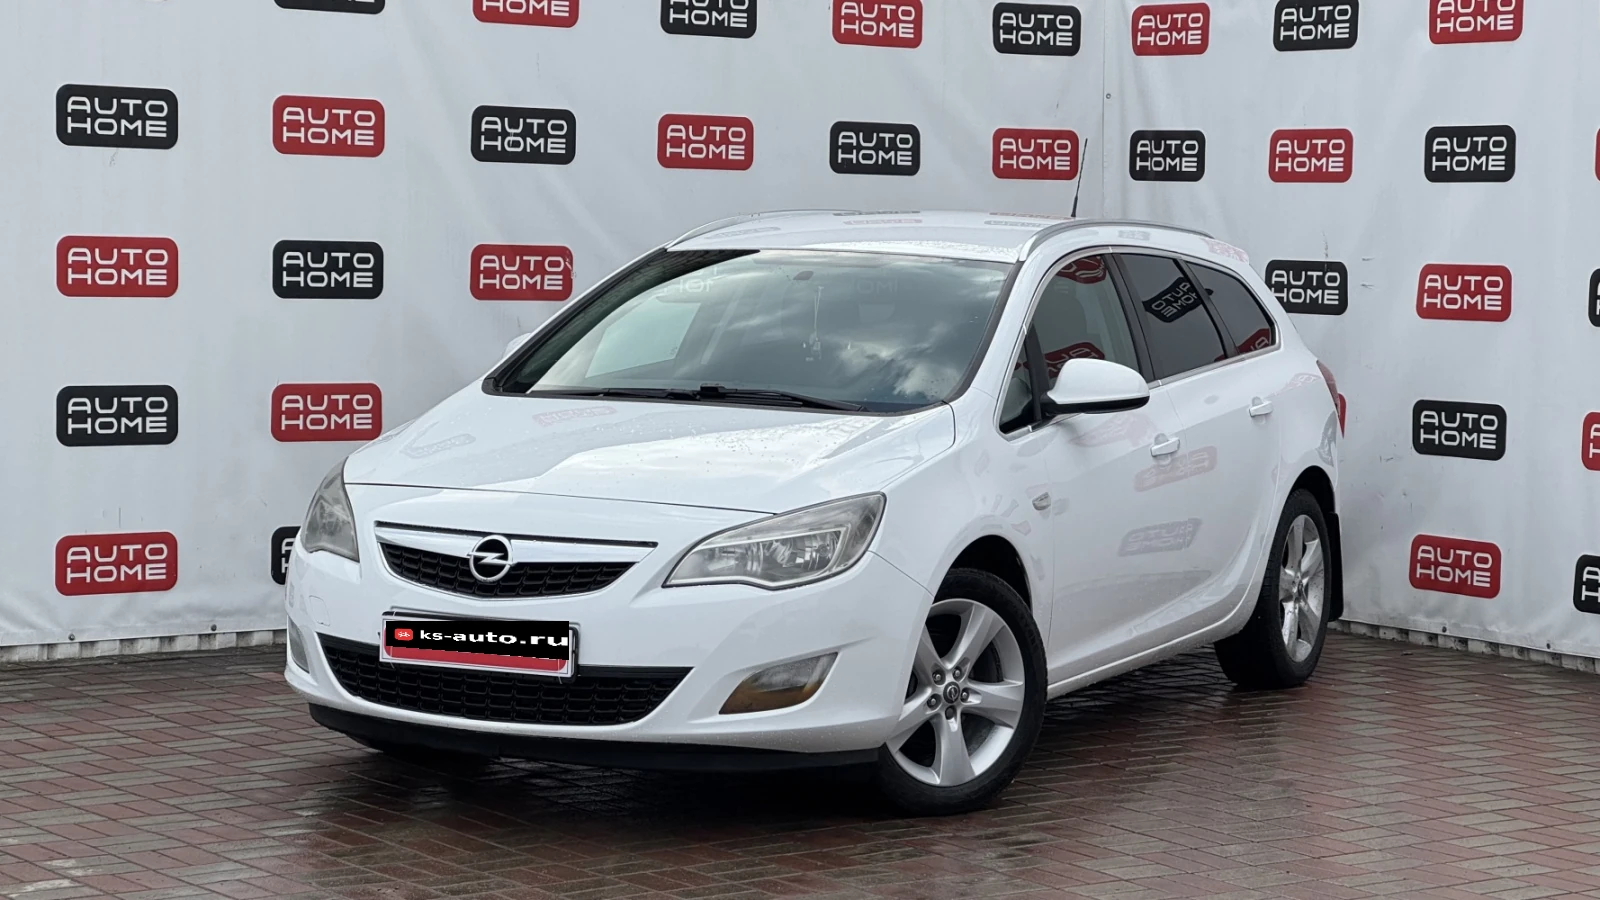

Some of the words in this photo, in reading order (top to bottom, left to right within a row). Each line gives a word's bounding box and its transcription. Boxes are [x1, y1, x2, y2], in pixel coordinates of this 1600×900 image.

[483, 0, 569, 17] HOME
[840, 1, 916, 21] AUTO
[1280, 4, 1352, 24] AUTO
[1436, 0, 1516, 15] AUTO
[669, 7, 748, 28] HOME
[999, 12, 1074, 30] AUTO
[1138, 12, 1204, 30] AUTO
[1436, 13, 1514, 34] HOME
[840, 18, 915, 39] HOME
[1136, 29, 1202, 46] HOME
[1279, 22, 1350, 41] HOME
[999, 29, 1073, 47] HOME
[67, 96, 169, 118] AUTO
[282, 106, 376, 127] AUTO
[67, 116, 167, 138] HOME
[480, 116, 568, 136] AUTO
[666, 124, 747, 143] AUTO
[282, 126, 375, 146] HOME
[480, 134, 567, 154] HOME
[838, 131, 913, 149] AUTO
[1432, 136, 1508, 153] AUTO
[666, 142, 745, 160] HOME
[1000, 137, 1072, 154] AUTO
[1136, 139, 1199, 155] AUTO
[1275, 138, 1346, 155] AUTO
[837, 148, 912, 166] HOME
[999, 154, 1071, 171] HOME
[1135, 156, 1198, 172] HOME
[1275, 156, 1344, 172] HOME
[1431, 155, 1506, 172] HOME
[67, 247, 169, 266] AUTO
[282, 251, 375, 269] AUTO
[479, 254, 565, 272] AUTO
[67, 267, 168, 286] HOME
[282, 270, 373, 288] HOME
[479, 273, 563, 291] HOME
[1271, 269, 1341, 287] AUTO
[1424, 274, 1504, 292] AUTO
[1271, 287, 1339, 305] HOME
[1423, 292, 1502, 311] HOME
[67, 396, 169, 415] AUTO
[281, 394, 374, 411] AUTO
[67, 416, 167, 435] HOME
[281, 413, 373, 431] HOME
[1420, 410, 1499, 431] AUTO
[1420, 428, 1497, 450] HOME
[66, 543, 168, 564] AUTO
[1417, 545, 1493, 569] AUTO
[66, 562, 167, 584] HOME
[1416, 563, 1491, 588] HOME
